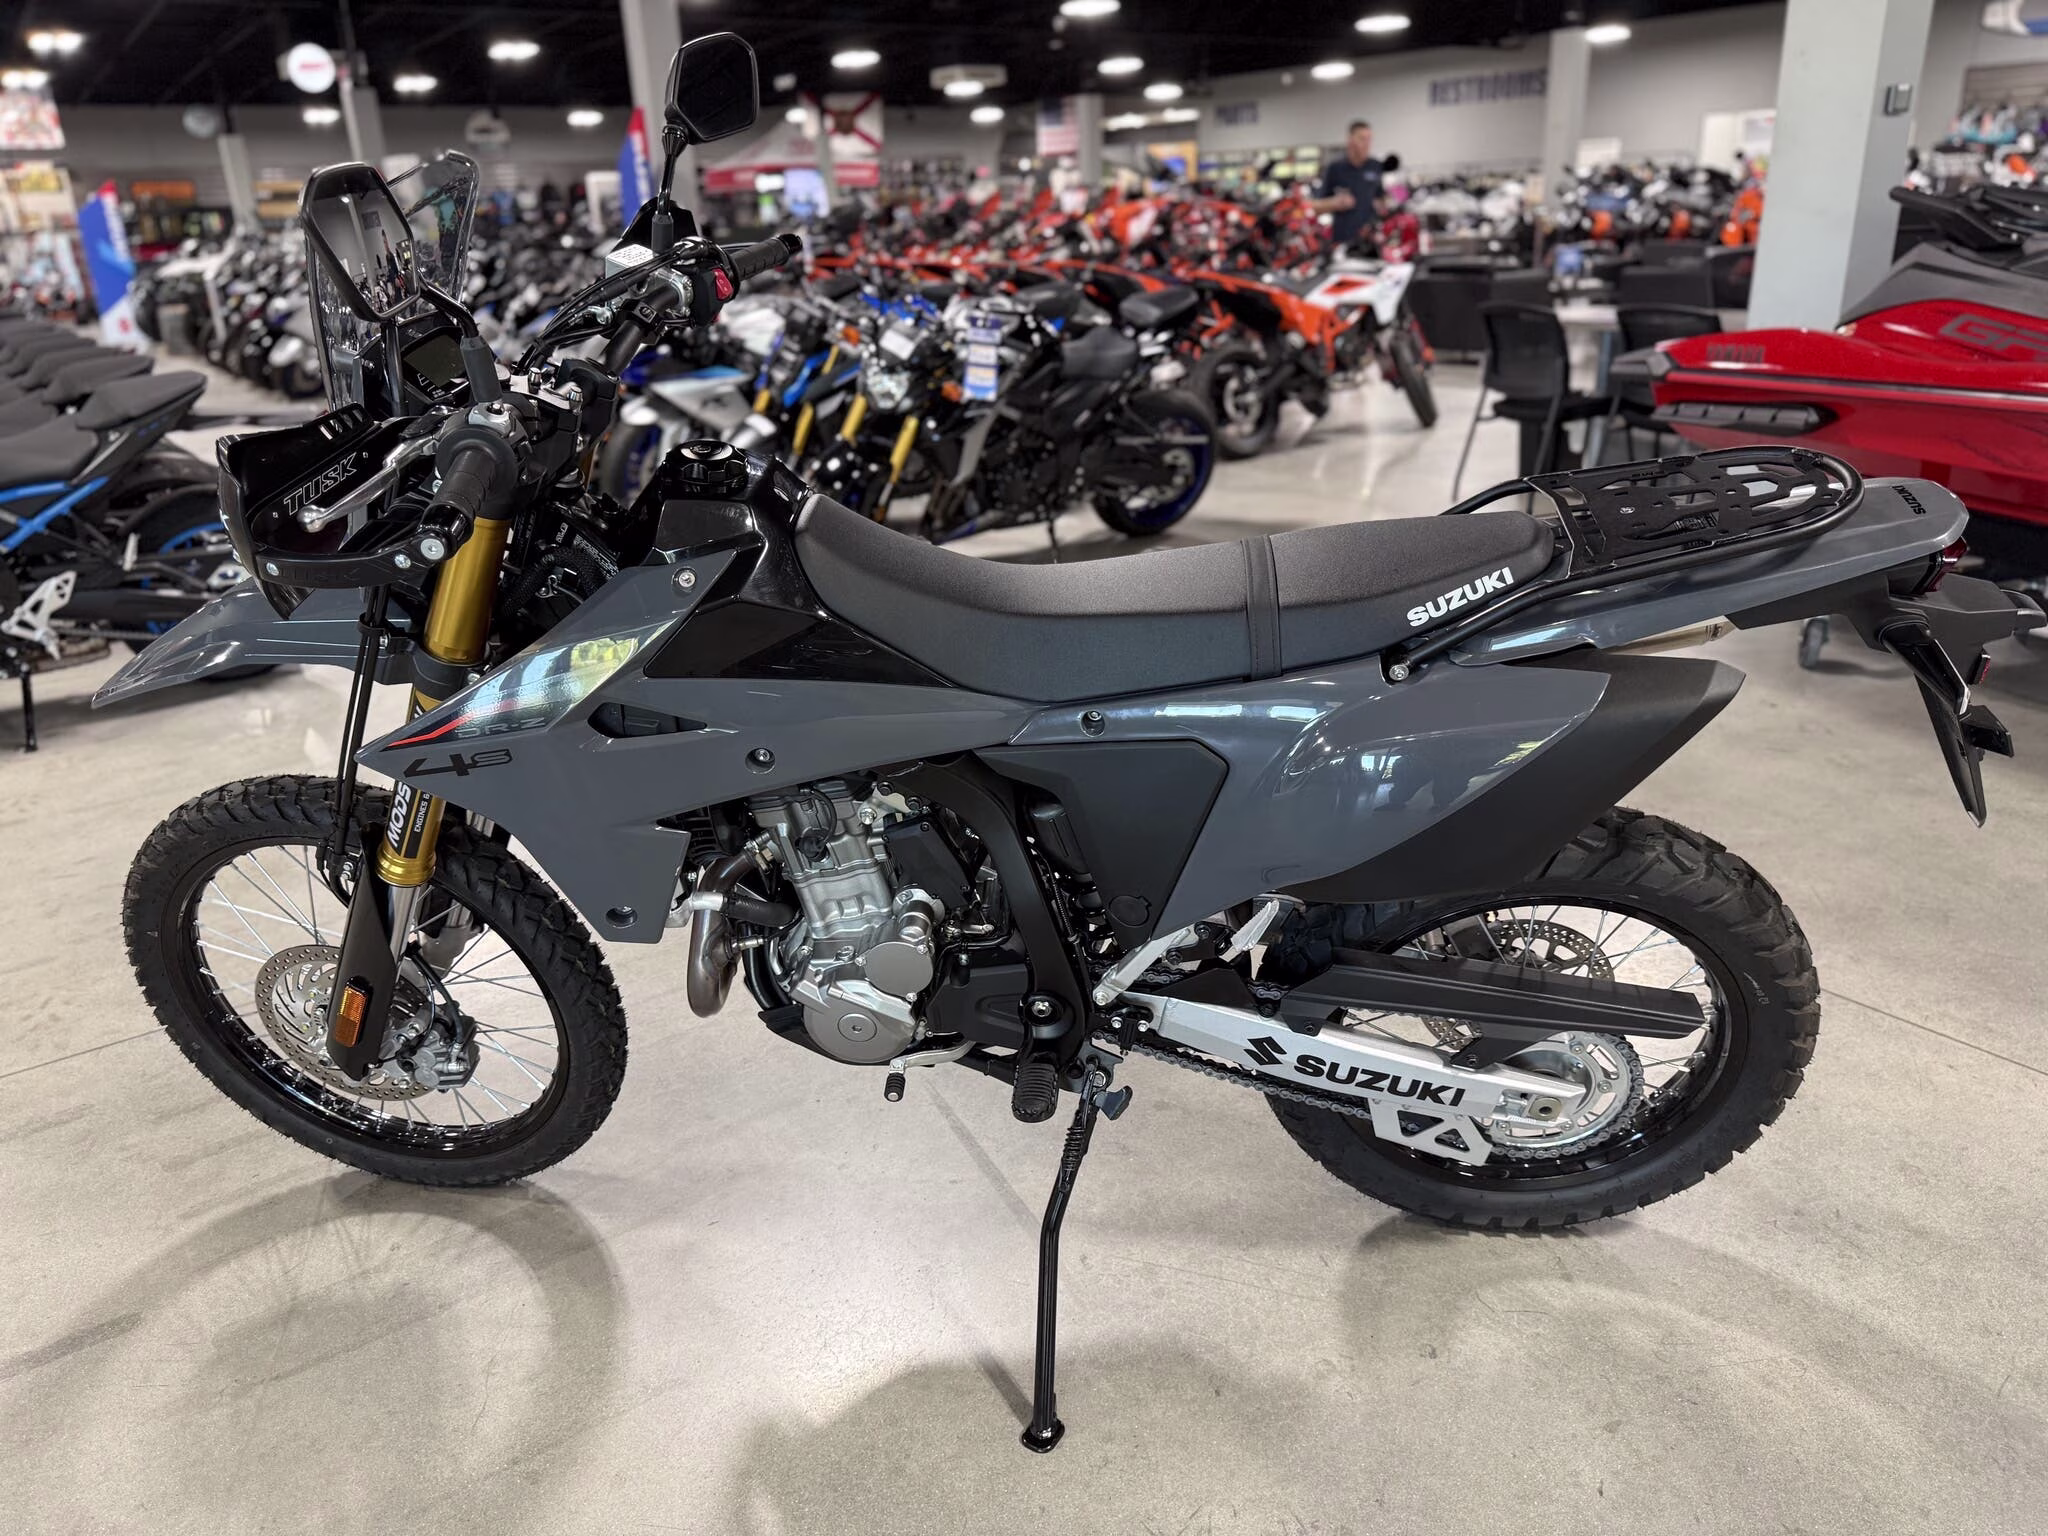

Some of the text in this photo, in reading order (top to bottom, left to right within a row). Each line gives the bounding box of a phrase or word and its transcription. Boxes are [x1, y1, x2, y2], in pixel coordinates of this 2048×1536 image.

[283, 451, 357, 516] TUSK
[1892, 485, 1927, 515] SUZUKI
[1406, 566, 1514, 627] SUZUKI
[386, 781, 412, 848] MODS
[413, 801, 429, 832] ENGINES
[1293, 1054, 1467, 1107] SUZUKI
